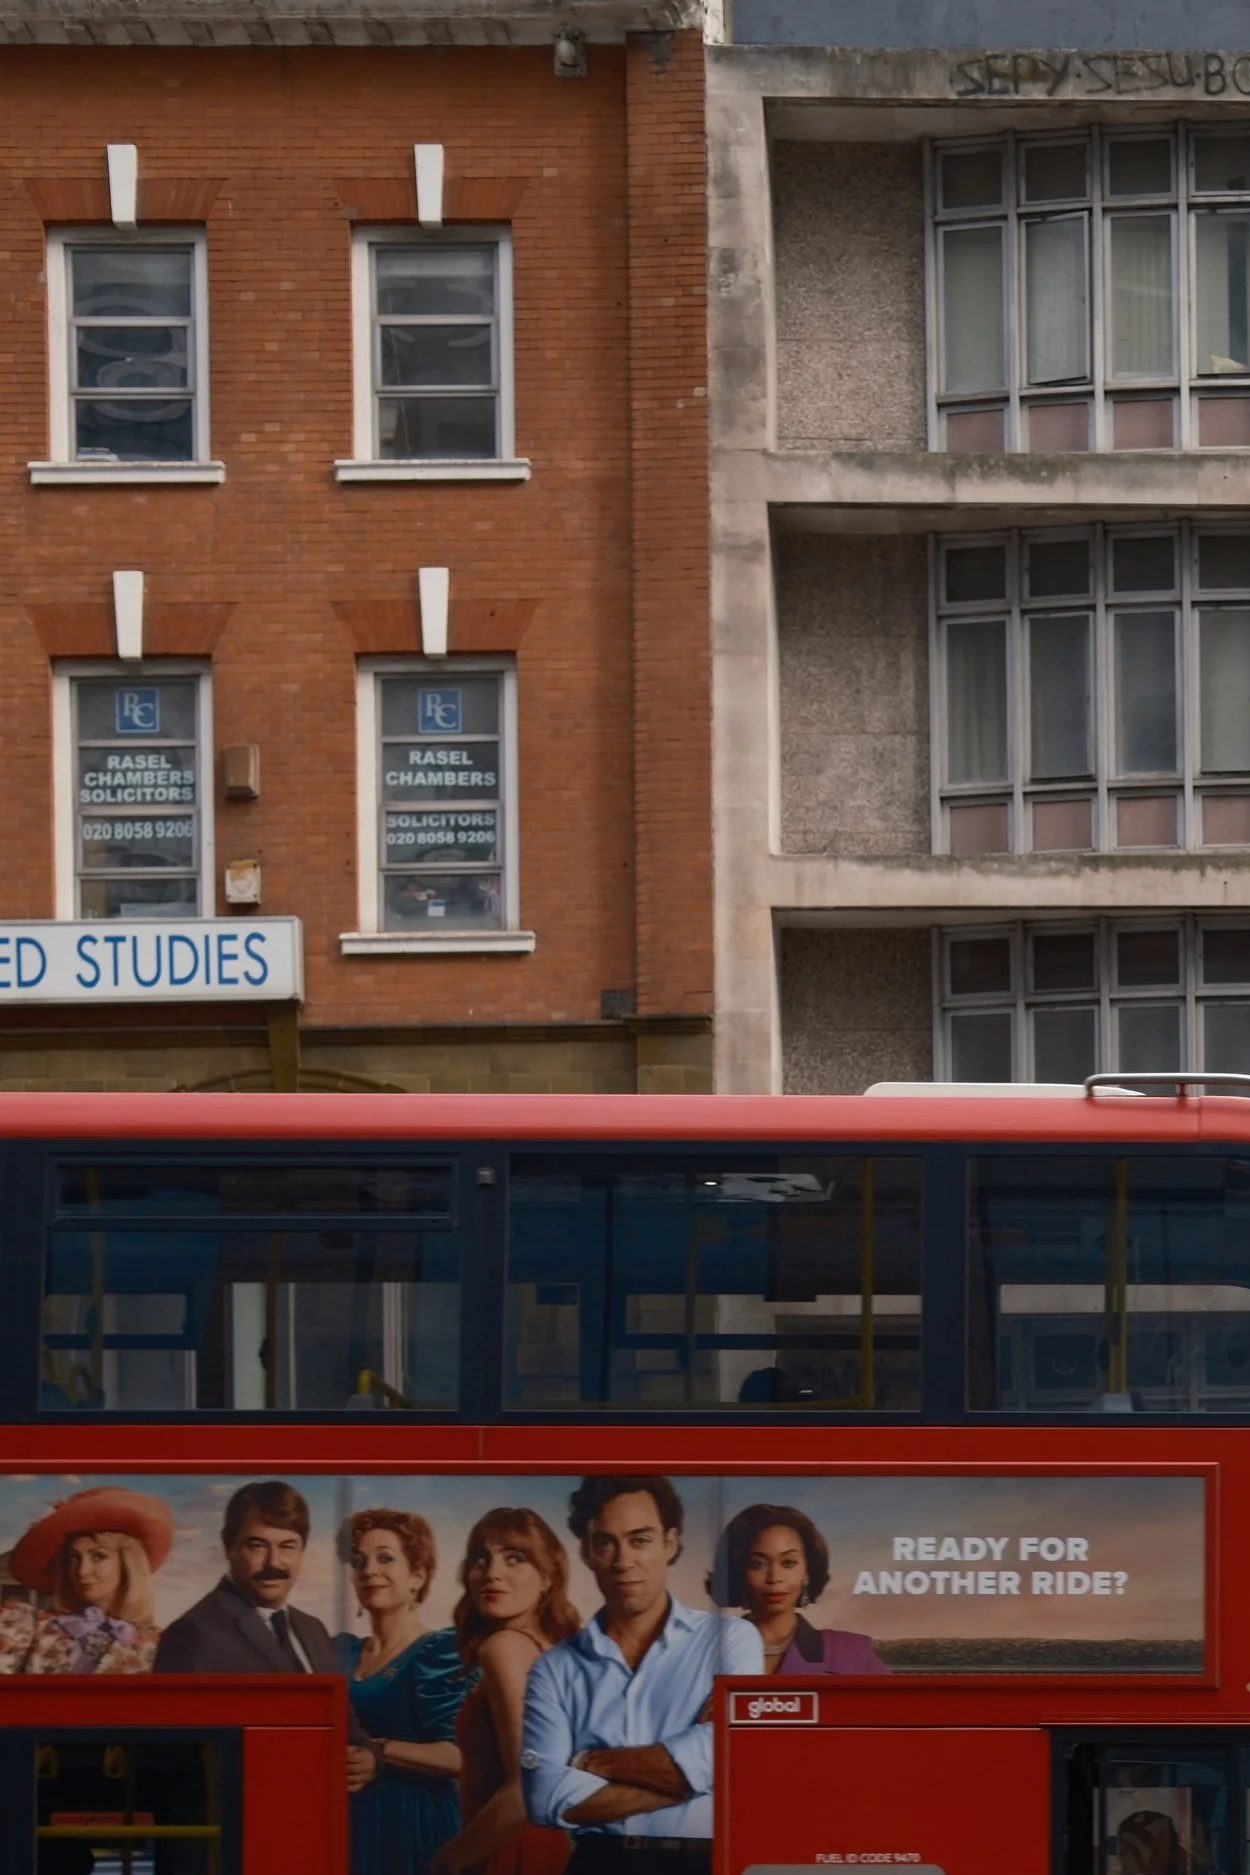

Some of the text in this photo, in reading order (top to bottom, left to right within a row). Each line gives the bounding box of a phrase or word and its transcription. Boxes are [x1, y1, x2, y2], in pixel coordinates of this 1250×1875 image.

[107, 755, 172, 769] RASEL
[409, 750, 474, 765] RASEL
[84, 770, 195, 786] CHAMBERS
[385, 771, 496, 786] CHAMBERS
[80, 787, 194, 803] SOLICITORS
[387, 812, 495, 828] SOLICITORS
[83, 822, 112, 840] 020
[114, 821, 153, 840] 8058
[387, 831, 496, 845] 020 8058 9206
[76, 932, 269, 989] STUDIES
[892, 1536, 1090, 1561] READY FOR
[852, 1570, 1129, 1596] ANOTHER RIDE?
[748, 1697, 802, 1719] global
[815, 1853, 845, 1863] FUEL
[845, 1853, 858, 1863] ID
[860, 1853, 892, 1863] CODE
